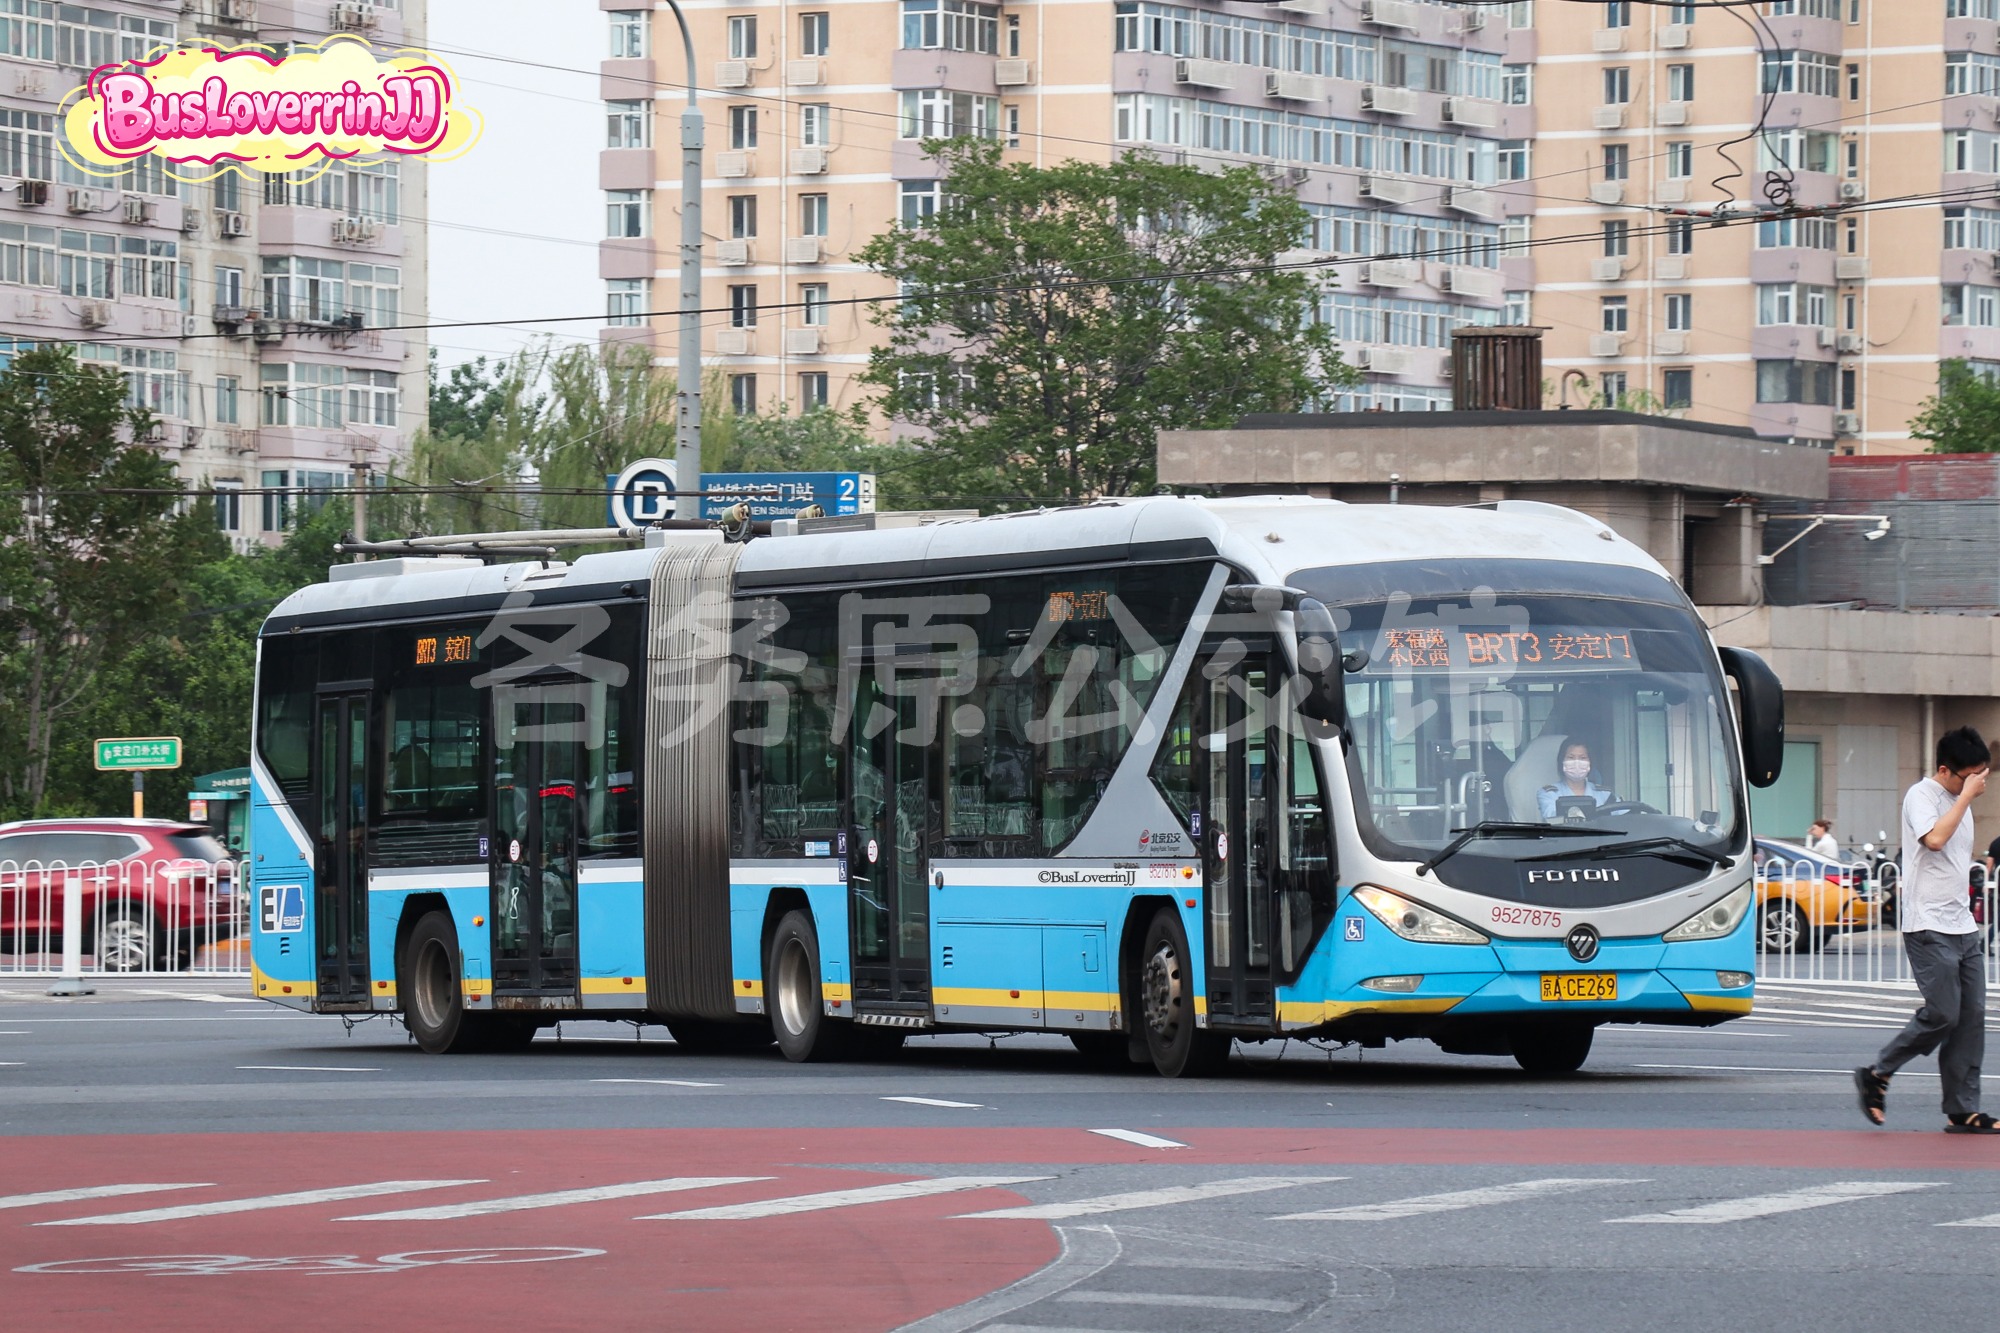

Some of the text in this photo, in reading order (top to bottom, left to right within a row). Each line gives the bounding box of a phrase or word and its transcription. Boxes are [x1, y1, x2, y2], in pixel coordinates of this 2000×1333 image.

[706, 483, 815, 503] 地铁安定门站
[840, 479, 855, 501] 2
[863, 479, 872, 503] B
[1049, 591, 1075, 622] BRT3
[1384, 628, 1447, 648] 宏福苑
[1465, 632, 1631, 663] BRT3 安定门
[416, 636, 471, 665] BRT3 安定门
[1388, 648, 1450, 667] 小区西
[112, 744, 170, 757] 安定门外大街
[1151, 832, 1181, 844] 北京公交
[1149, 863, 1177, 878] 9527875
[1528, 868, 1620, 883] FOTON
[1491, 906, 1562, 928] 9527875
